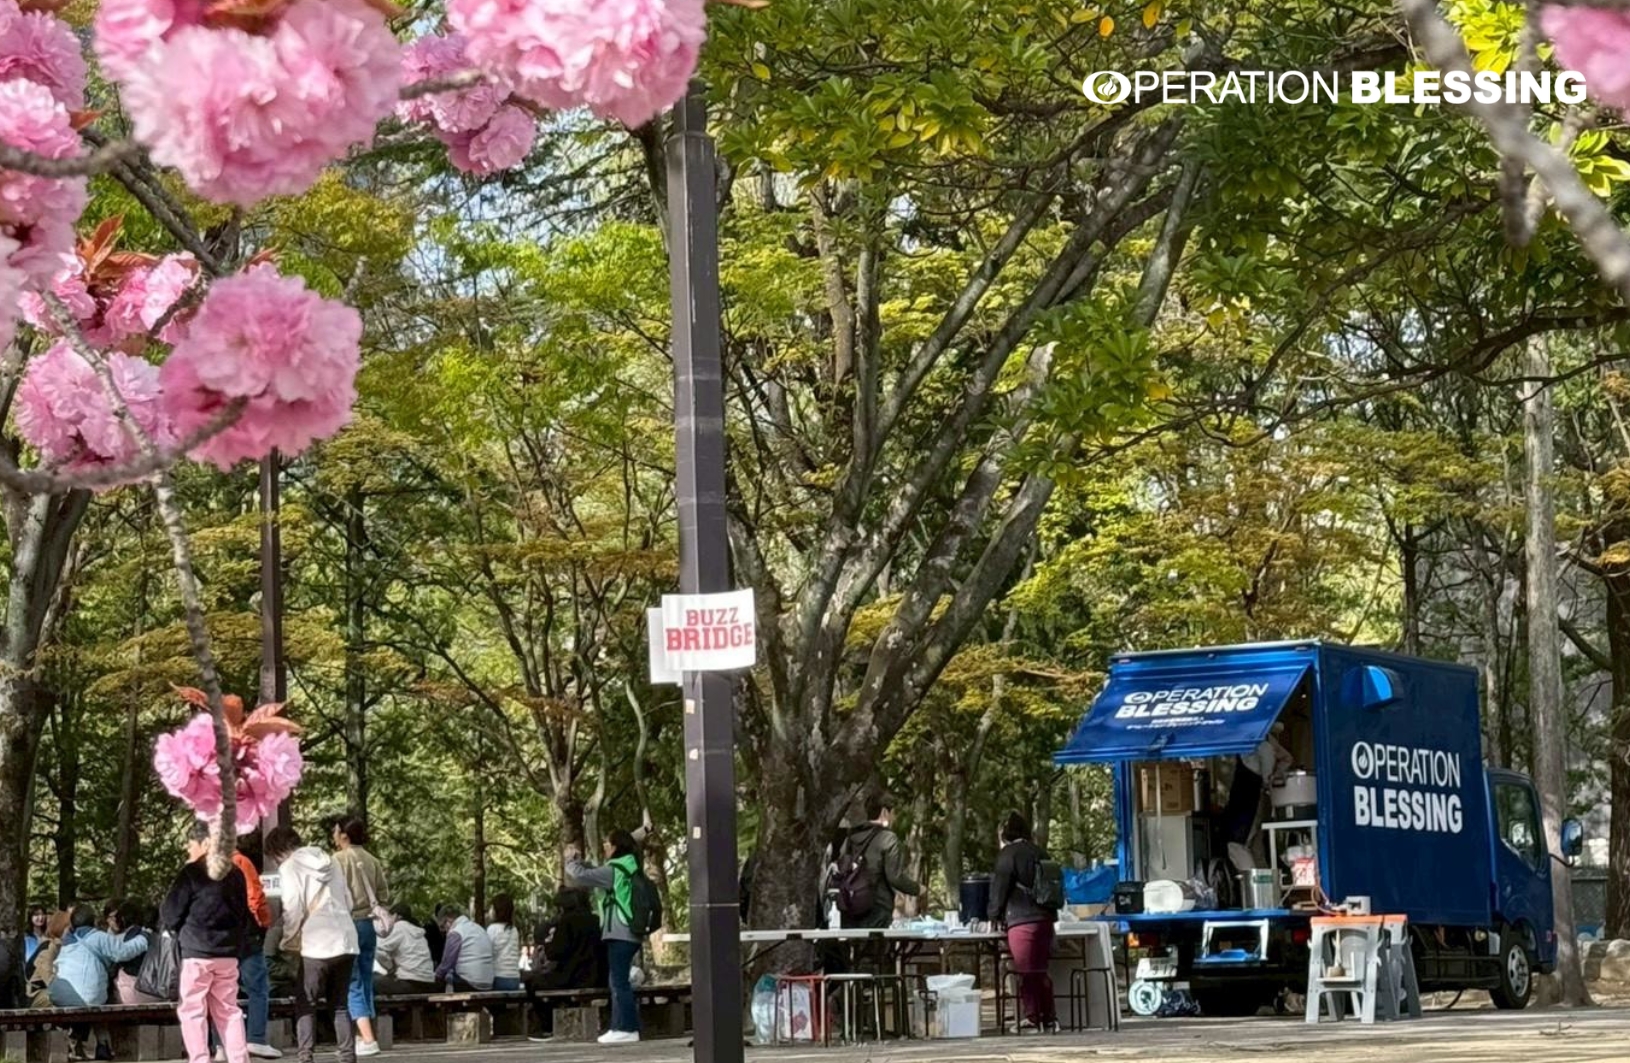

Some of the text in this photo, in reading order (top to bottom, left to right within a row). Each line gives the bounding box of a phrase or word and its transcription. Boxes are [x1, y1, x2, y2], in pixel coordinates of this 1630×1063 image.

[686, 607, 739, 627] BUZZ
[665, 622, 753, 651] BRIDGE
[1124, 683, 1269, 704] OPERATION
[1115, 696, 1259, 719] BLESSING
[1351, 741, 1461, 788] OPERATION
[1354, 785, 1463, 833] BLESSING
